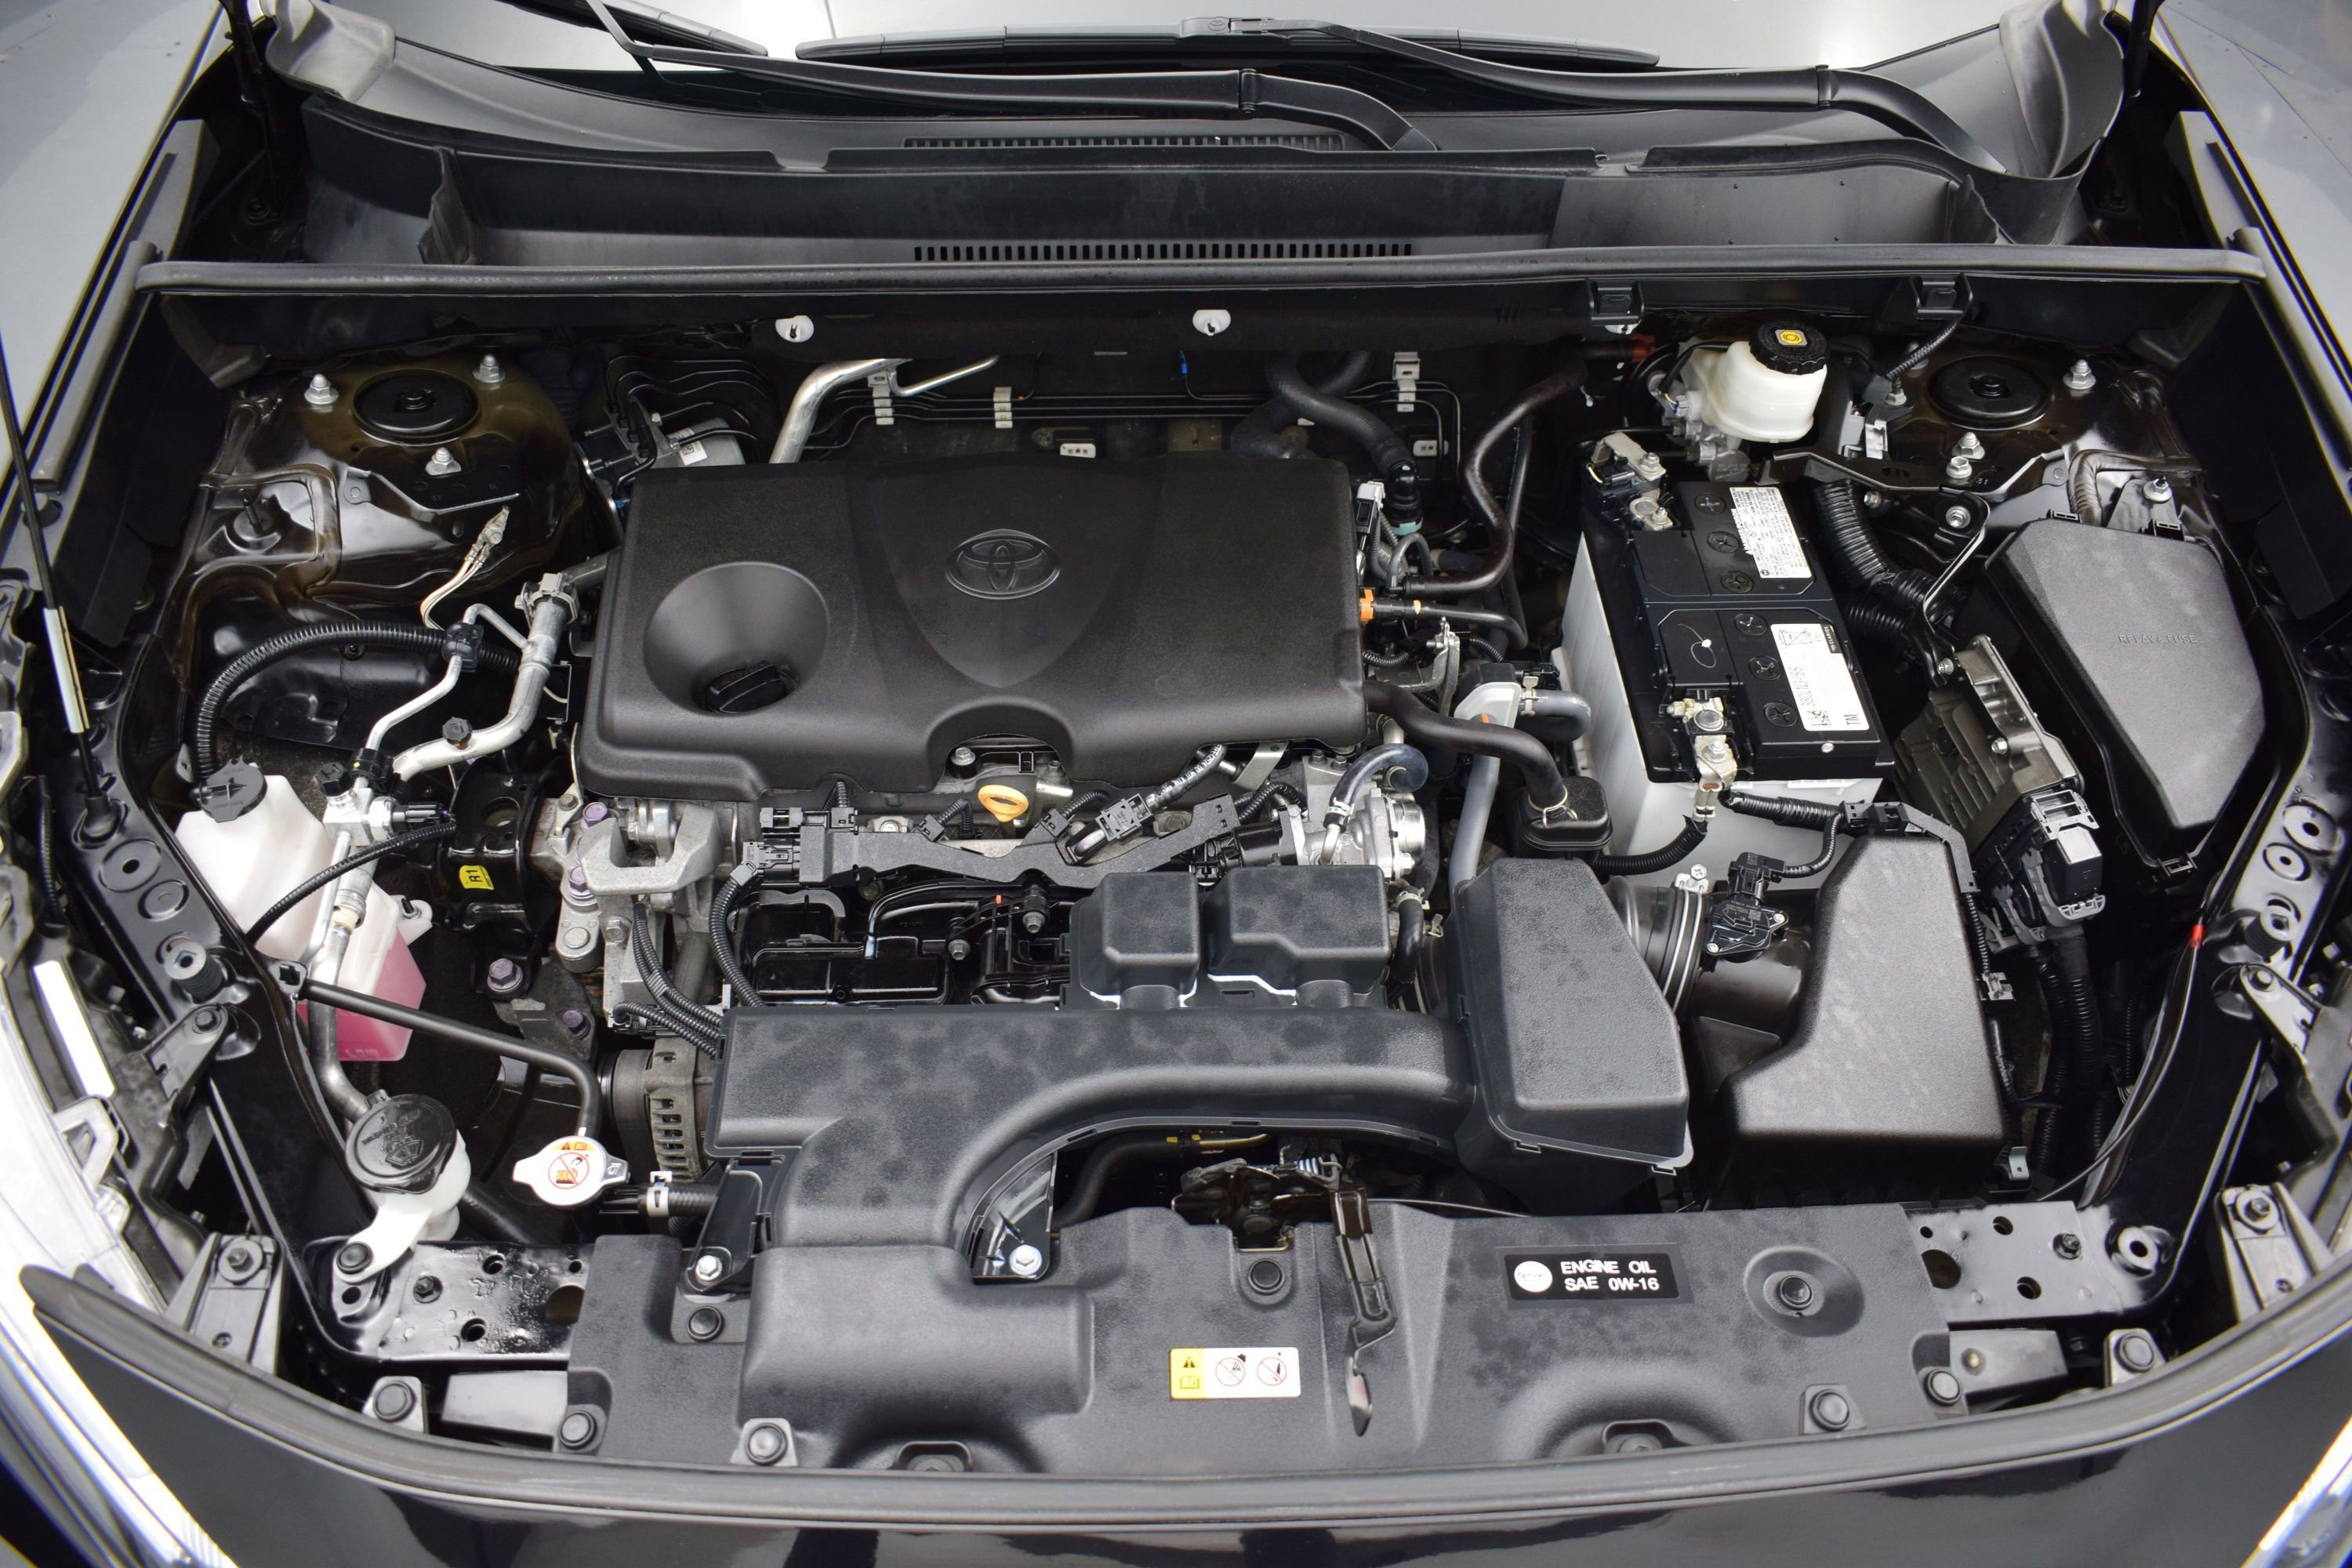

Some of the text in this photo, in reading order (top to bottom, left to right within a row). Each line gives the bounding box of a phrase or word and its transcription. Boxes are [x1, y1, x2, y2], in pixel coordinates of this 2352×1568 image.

[2166, 633, 2197, 643] FUSE
[1844, 714, 1861, 726] TM
[465, 869, 483, 883] R1
[1560, 1259, 1657, 1275] ENGINE OIL
[1564, 1276, 1660, 1291] SAE 0W-16
